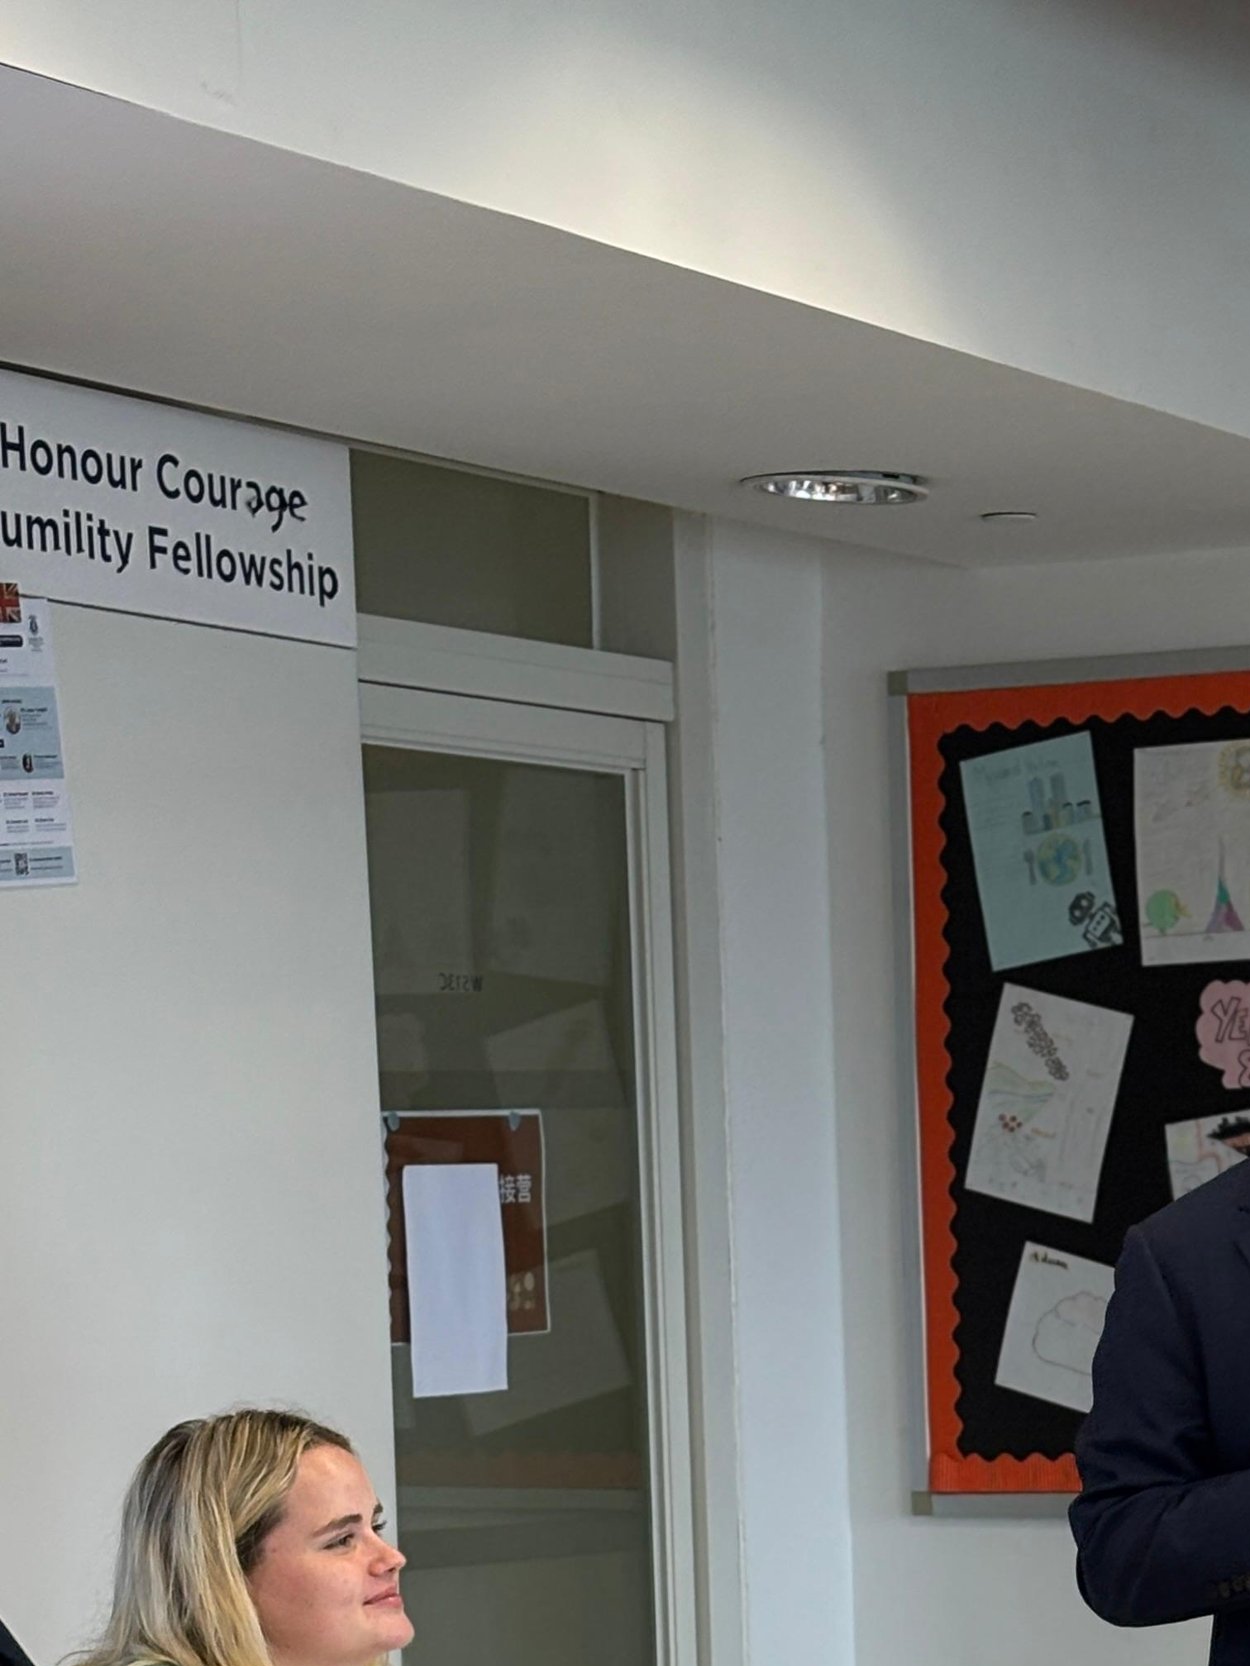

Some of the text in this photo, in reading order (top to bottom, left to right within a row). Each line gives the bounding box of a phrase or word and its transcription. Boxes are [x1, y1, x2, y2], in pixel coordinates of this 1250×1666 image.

[0, 421, 308, 532] Honour Courage
[148, 525, 339, 607] Fellowship
